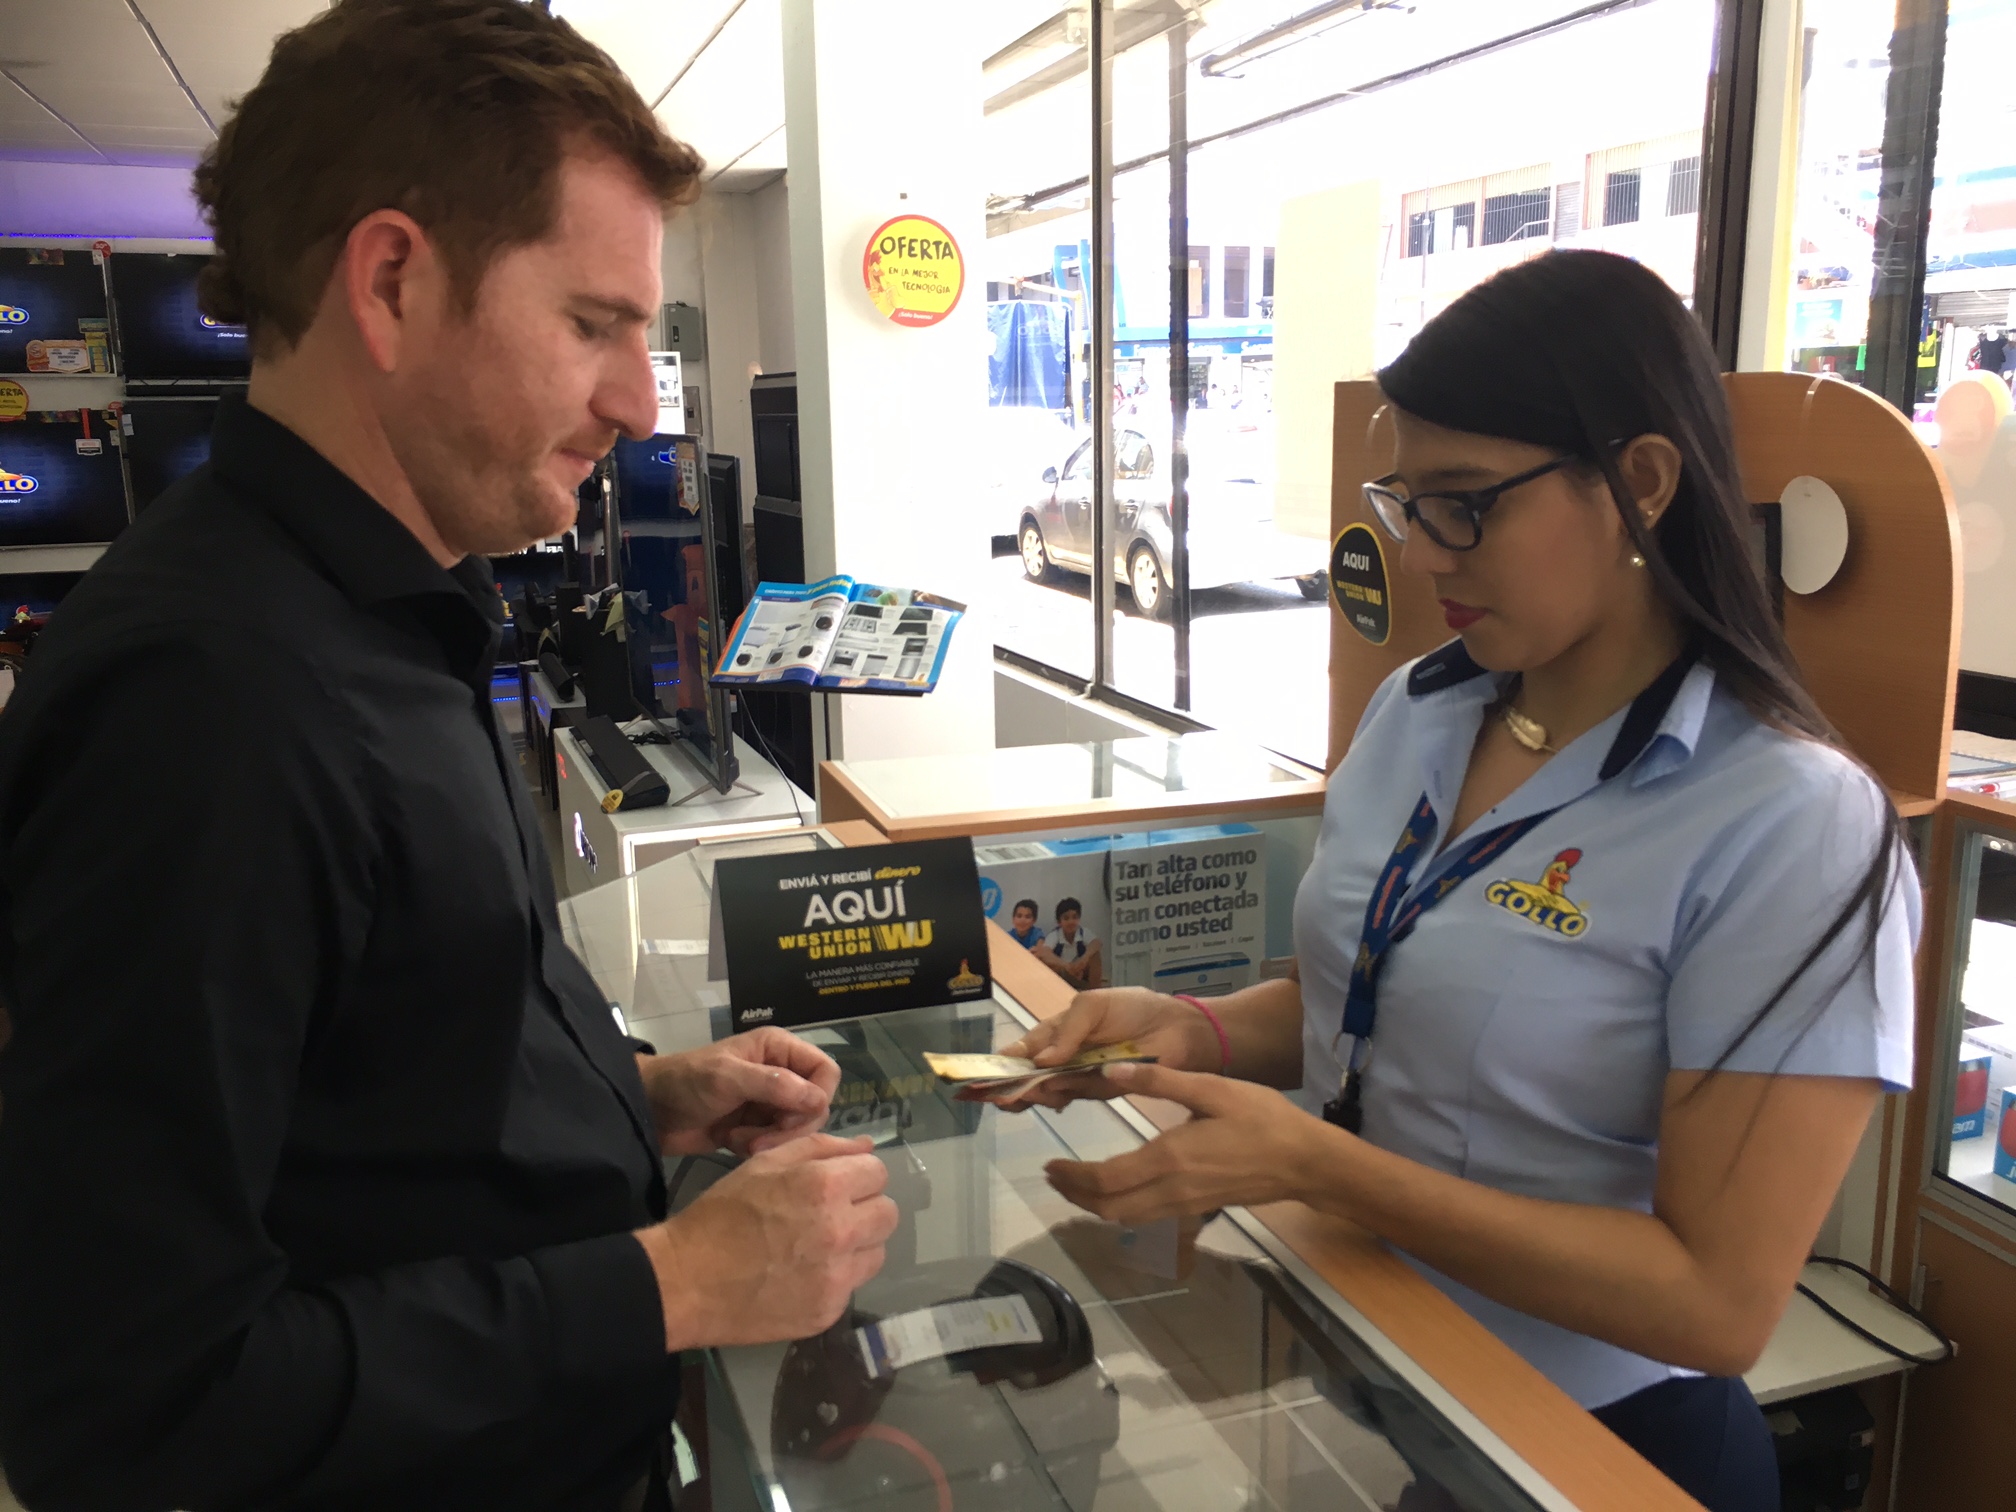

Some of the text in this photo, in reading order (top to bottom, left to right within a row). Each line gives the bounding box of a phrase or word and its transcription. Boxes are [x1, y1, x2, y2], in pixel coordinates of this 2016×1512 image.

[880, 236, 954, 261] OFERTA
[902, 268, 910, 276] LA
[912, 270, 939, 279] MEJOR
[0, 478, 34, 490] LO
[1342, 552, 1370, 572] AQUI
[1115, 848, 1257, 880] Tan alta como
[778, 866, 922, 890] ENVIÁ Y RECIBÍ dinero
[1115, 871, 1248, 902] su teléfono y
[804, 880, 907, 928] AQUÍ
[1115, 890, 1260, 926] tan conectada
[1486, 882, 1588, 936] GOLLO
[778, 919, 934, 950] WESTERN WU
[1116, 913, 1234, 946] como usted
[809, 940, 872, 960] UNION
[806, 972, 817, 980] LA
[818, 966, 854, 977] MANERA
[875, 958, 920, 970] CONFIABLE
[740, 1006, 774, 1020] AirPak
